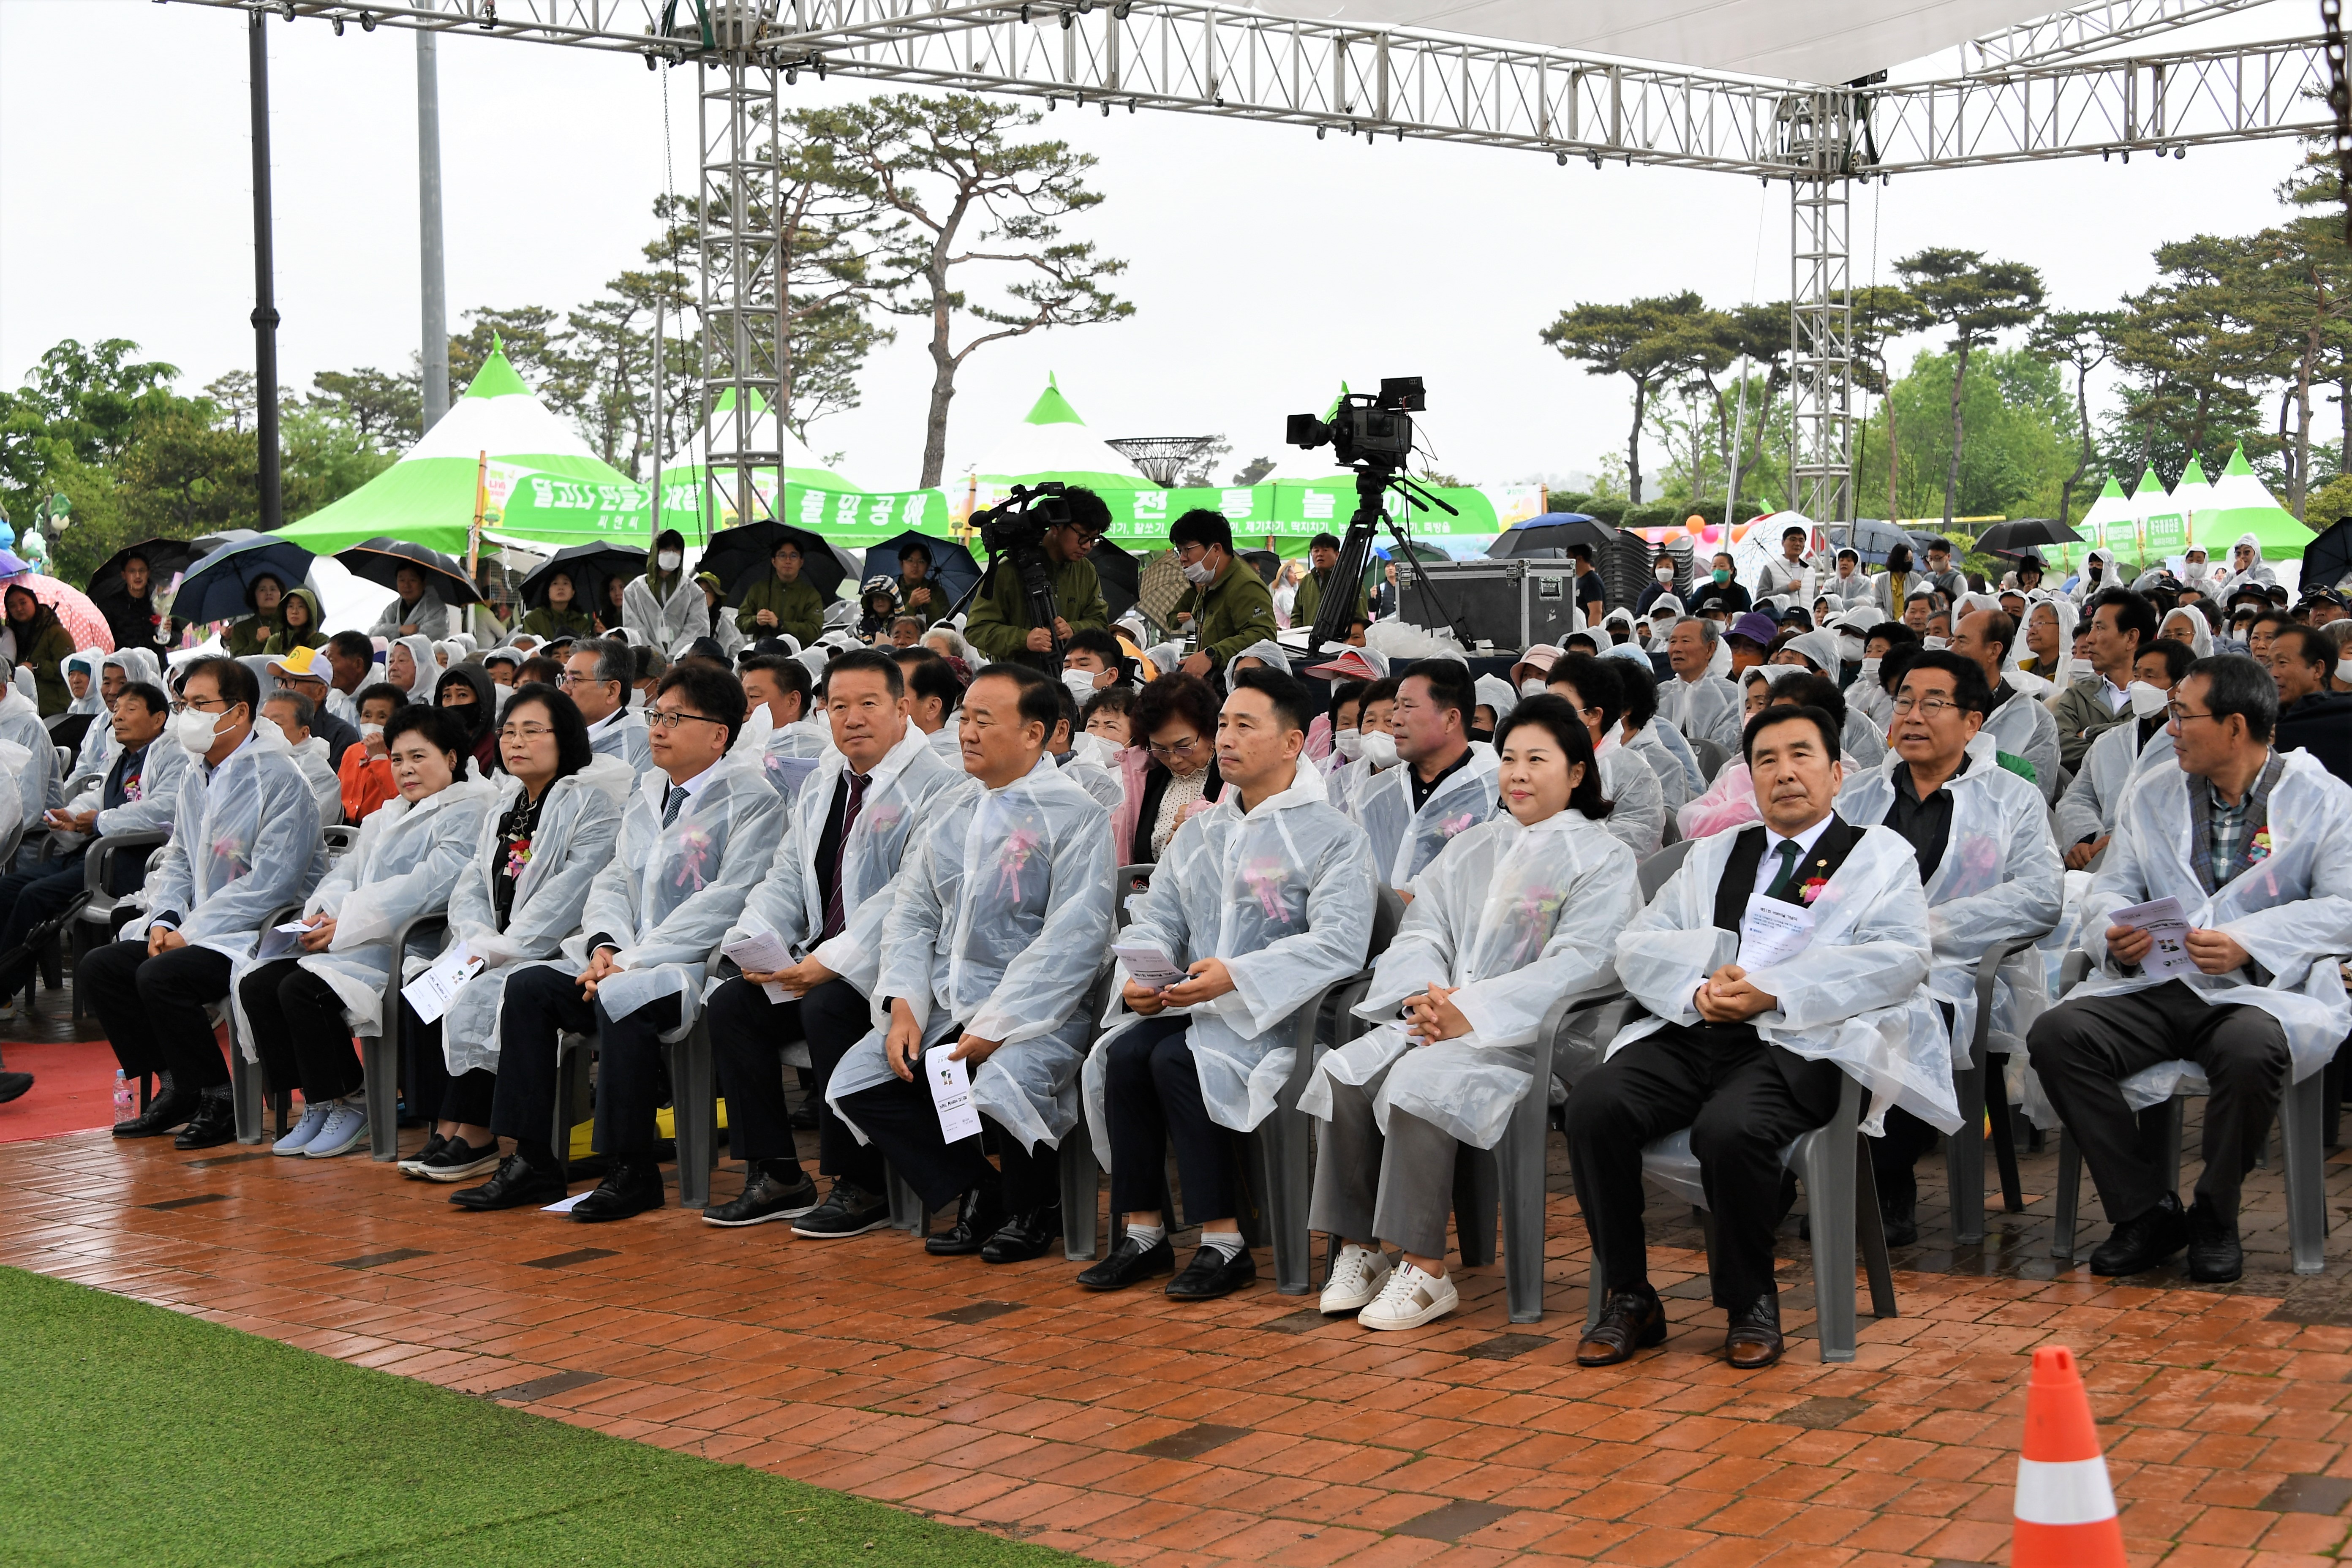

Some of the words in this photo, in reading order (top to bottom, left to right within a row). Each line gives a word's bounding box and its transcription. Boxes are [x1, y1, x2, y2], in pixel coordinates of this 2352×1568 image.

[531, 478, 596, 510] 달고나
[598, 486, 657, 512] 만들기
[663, 483, 702, 511] 체험
[1134, 522, 1168, 535] 활쏘기,
[1245, 521, 1288, 533] 제기차기,
[1290, 521, 1331, 534] 딱지치기,
